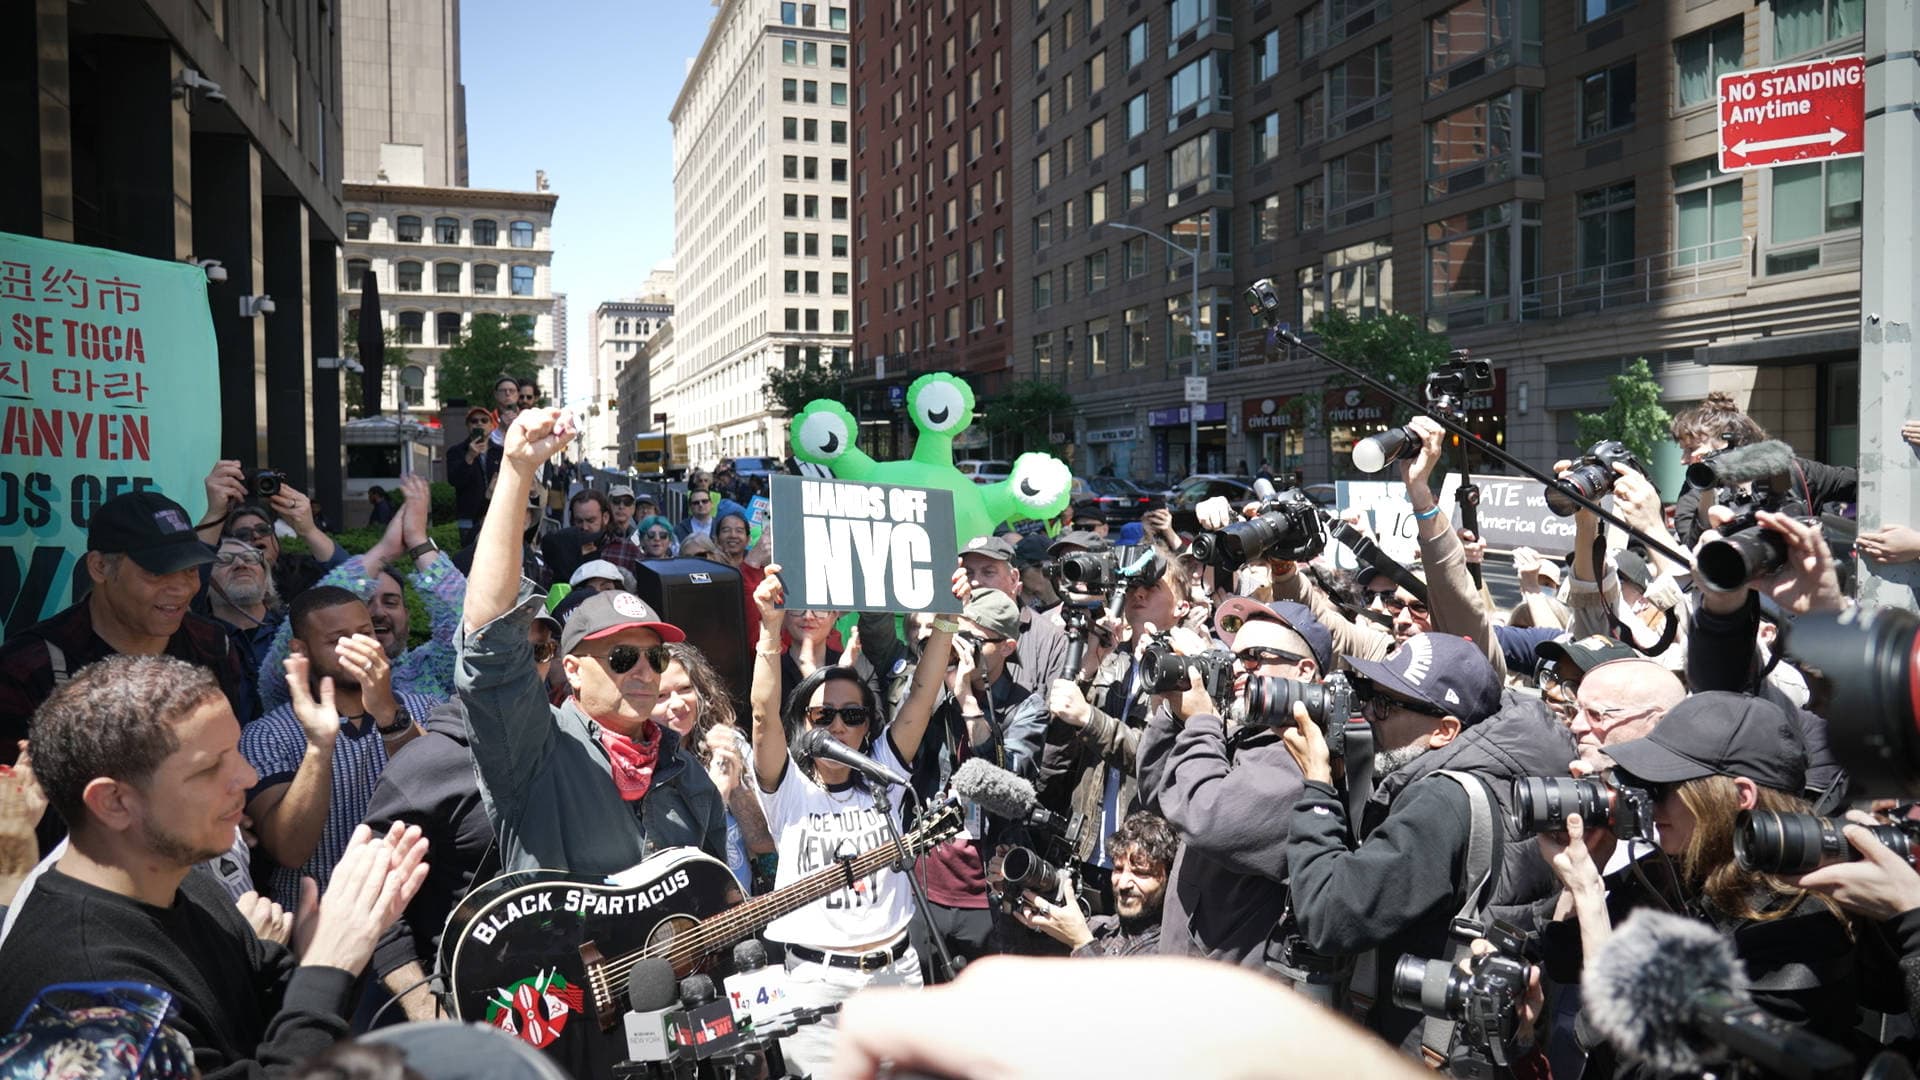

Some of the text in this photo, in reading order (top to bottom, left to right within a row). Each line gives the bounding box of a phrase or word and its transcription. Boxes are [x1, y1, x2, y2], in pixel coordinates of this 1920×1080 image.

[1729, 65, 1861, 103] NO STANDING
[1730, 99, 1811, 125] Anytime
[12, 313, 146, 364] SE TOCA
[53, 368, 149, 403] 마라
[1, 406, 150, 461] ANYEN
[801, 480, 928, 523] HANDS OFF
[1475, 482, 1524, 507] ATE
[1476, 511, 1577, 537] America Grea
[803, 516, 935, 610] NYC
[473, 868, 690, 945] BLACK SPARTACUS
[756, 986, 769, 1004] 4
